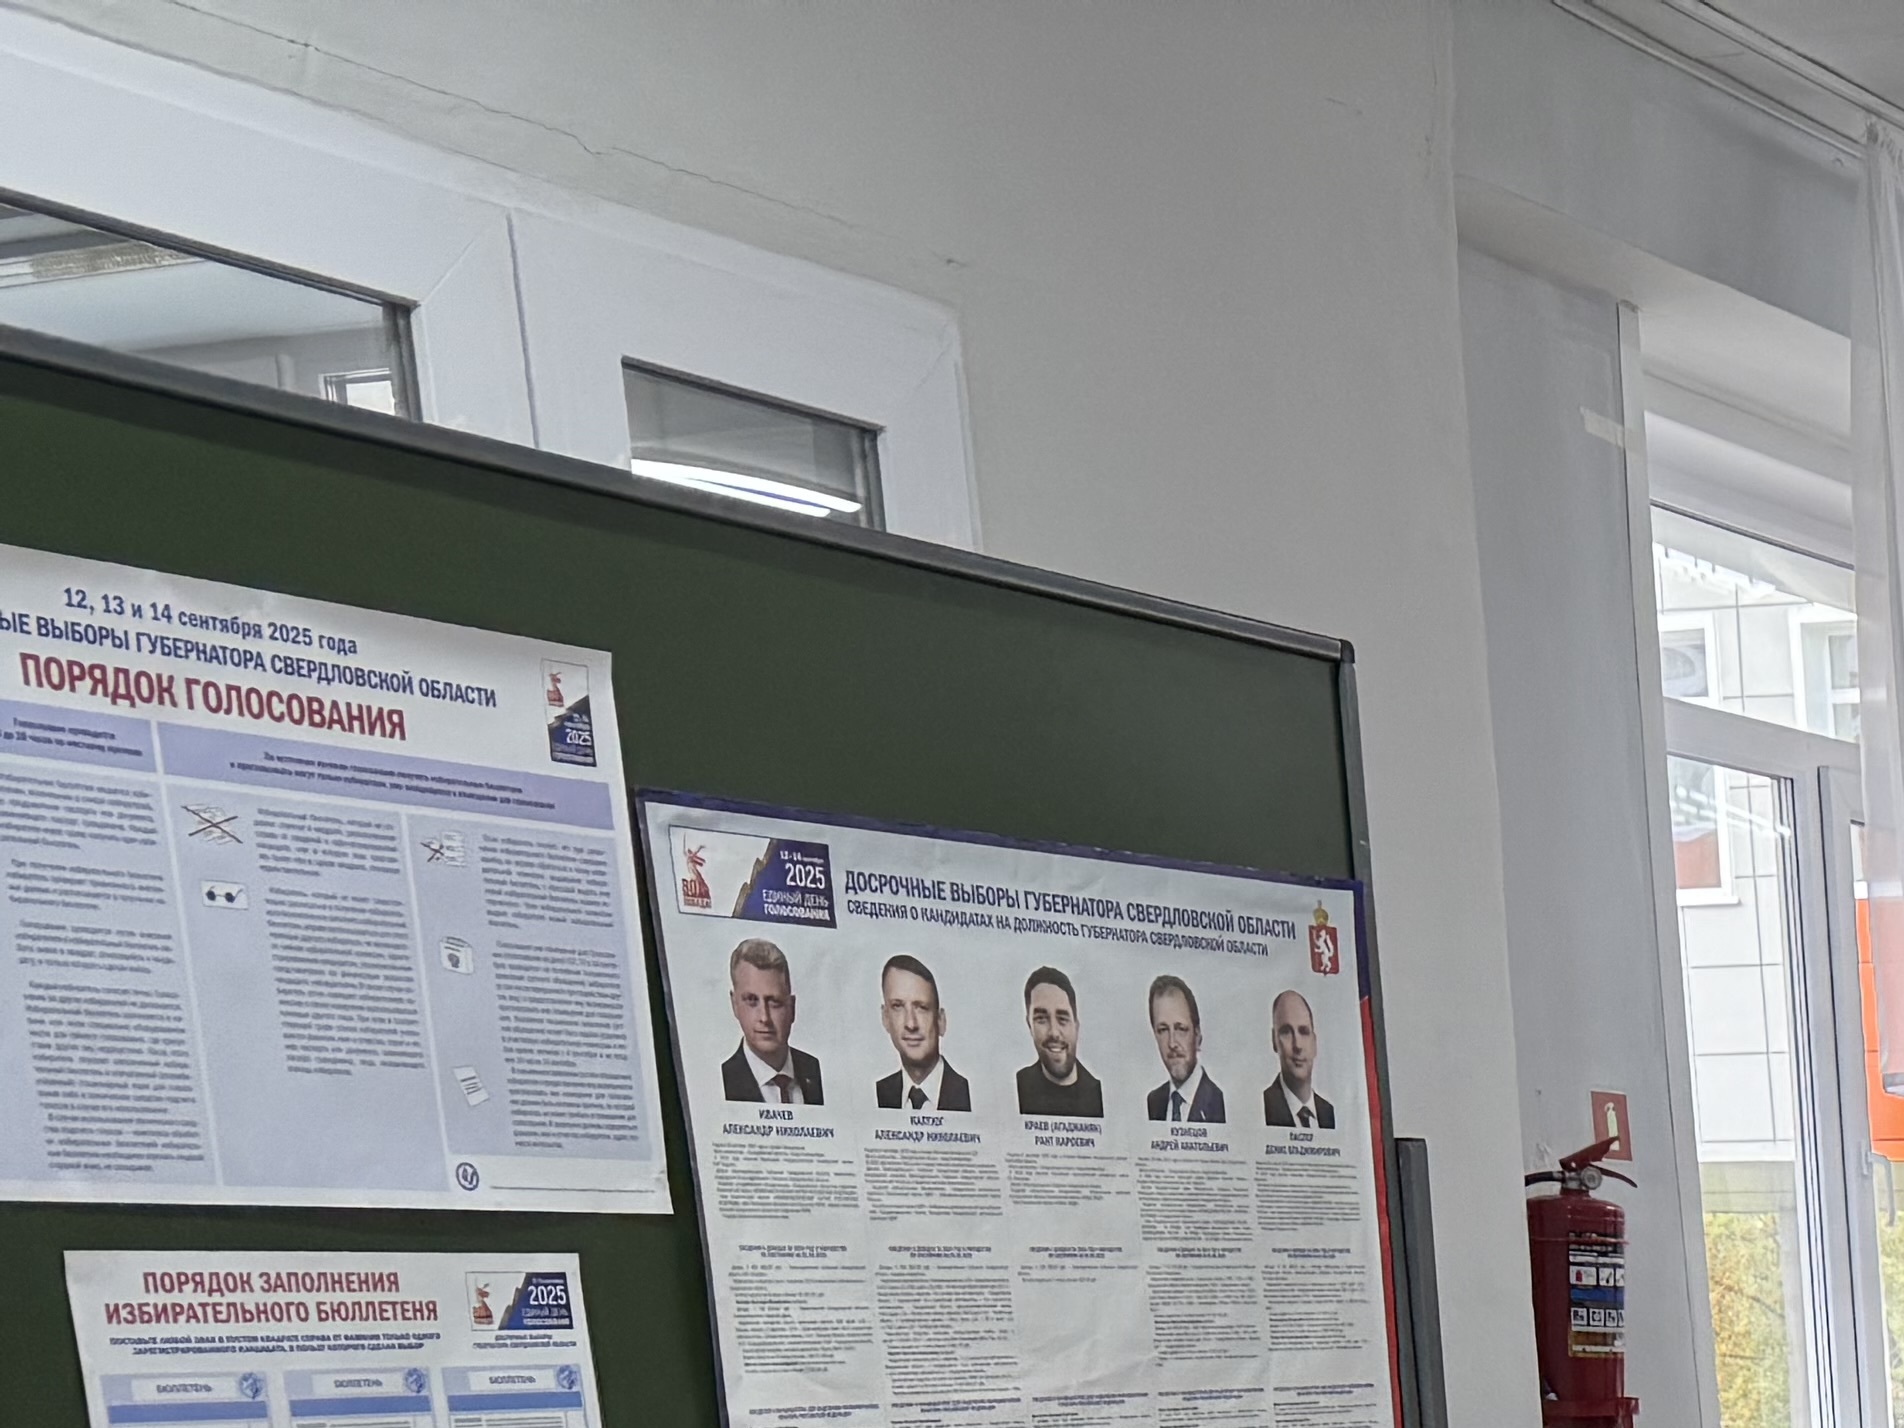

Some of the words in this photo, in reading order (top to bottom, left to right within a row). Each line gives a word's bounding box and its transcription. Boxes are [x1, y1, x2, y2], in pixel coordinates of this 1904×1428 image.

[64, 587, 95, 615] 12,
[101, 593, 125, 616] 13
[131, 602, 143, 619] и
[150, 602, 172, 624] 14
[178, 610, 263, 640] сентября
[268, 622, 313, 646] 2025
[319, 634, 358, 656] года
[36, 615, 130, 650] ВЫБОРЫ
[136, 632, 267, 673] ГУБЕРНАТОРА
[271, 654, 415, 695] СВЕРДЛОВСКОЙ
[419, 677, 497, 708] ОБЛАСТИ
[19, 652, 178, 708] ПОРЯДОК
[184, 677, 407, 741] ГОЛОСОВАНИЯ
[785, 863, 825, 889] 2025
[845, 870, 947, 901] ДОСРОЧНЫЕ
[950, 881, 1020, 909] ВЫБОРЫ
[1024, 890, 1124, 921] ГУБЕРНАТОРА
[1127, 902, 1235, 933] СВЕРДЛОВСКОЙ
[1238, 916, 1297, 940] ОБЛАСТИ
[847, 900, 908, 920] СВЕДЕНИЯ
[911, 906, 919, 920] О
[921, 907, 994, 929] КАНДИДАТАХ
[996, 915, 1012, 930] НА
[1014, 917, 1079, 937] ДОЛЖНОСТЬ
[1081, 923, 1149, 944] ГУБЕРНАТОРА
[1226, 940, 1269, 957] ОБЛАСТИ
[104, 1301, 310, 1325] ИЗБИРАТЕЛЬНОГО
[316, 1300, 438, 1323] БЮЛЛЕТЕНЯ
[143, 1271, 255, 1297] ПОРЯДОК
[259, 1271, 400, 1294] ЗАПОЛНЕНИЯ
[528, 1285, 567, 1305] 2025
